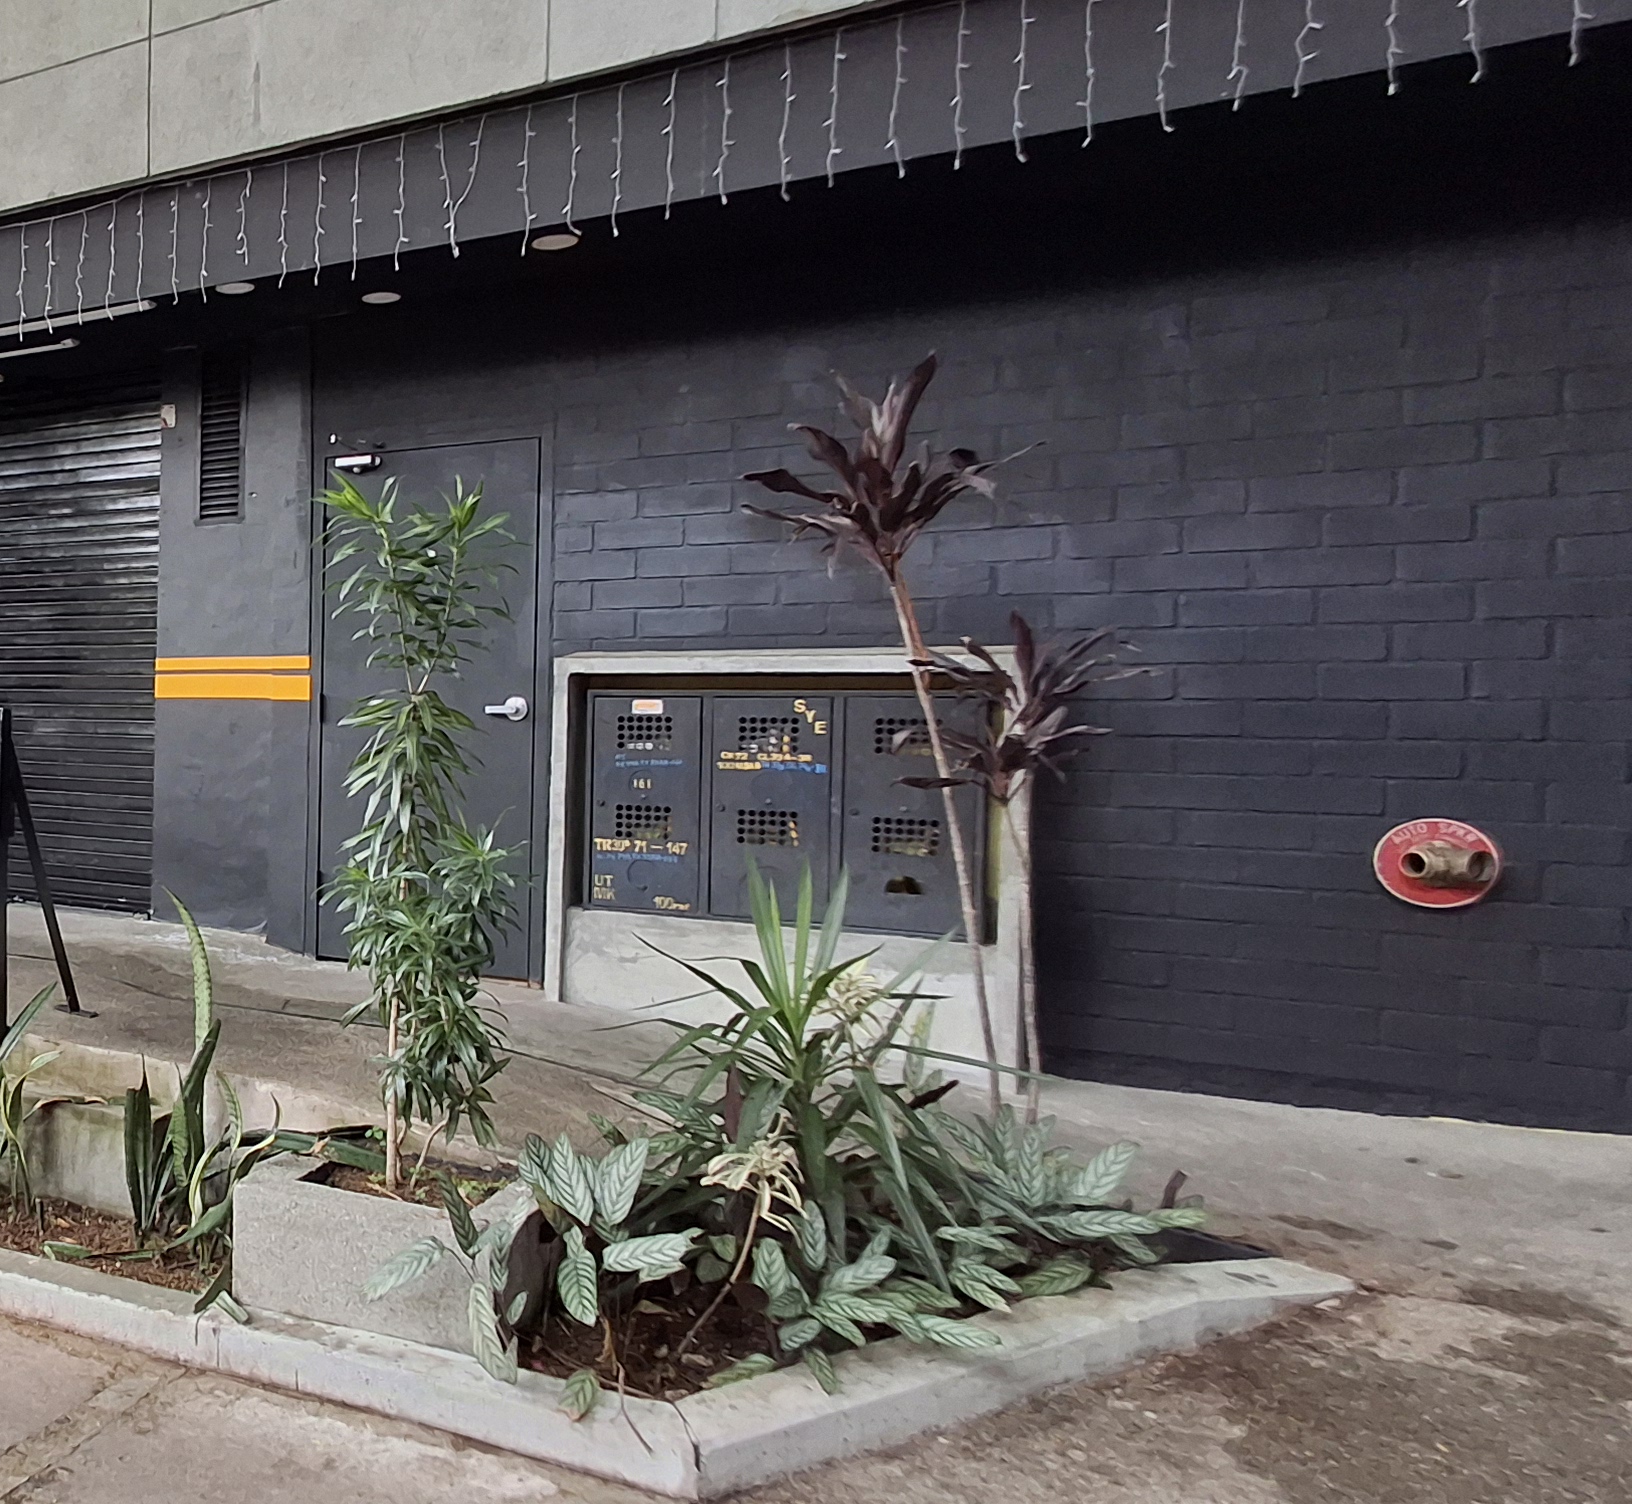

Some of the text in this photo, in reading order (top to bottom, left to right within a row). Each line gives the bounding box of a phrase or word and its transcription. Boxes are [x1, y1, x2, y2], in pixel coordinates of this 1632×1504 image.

[633, 778, 652, 789] 161
[1390, 822, 1429, 845] AUTO
[666, 842, 688, 855] 147
[594, 874, 614, 887] UT
